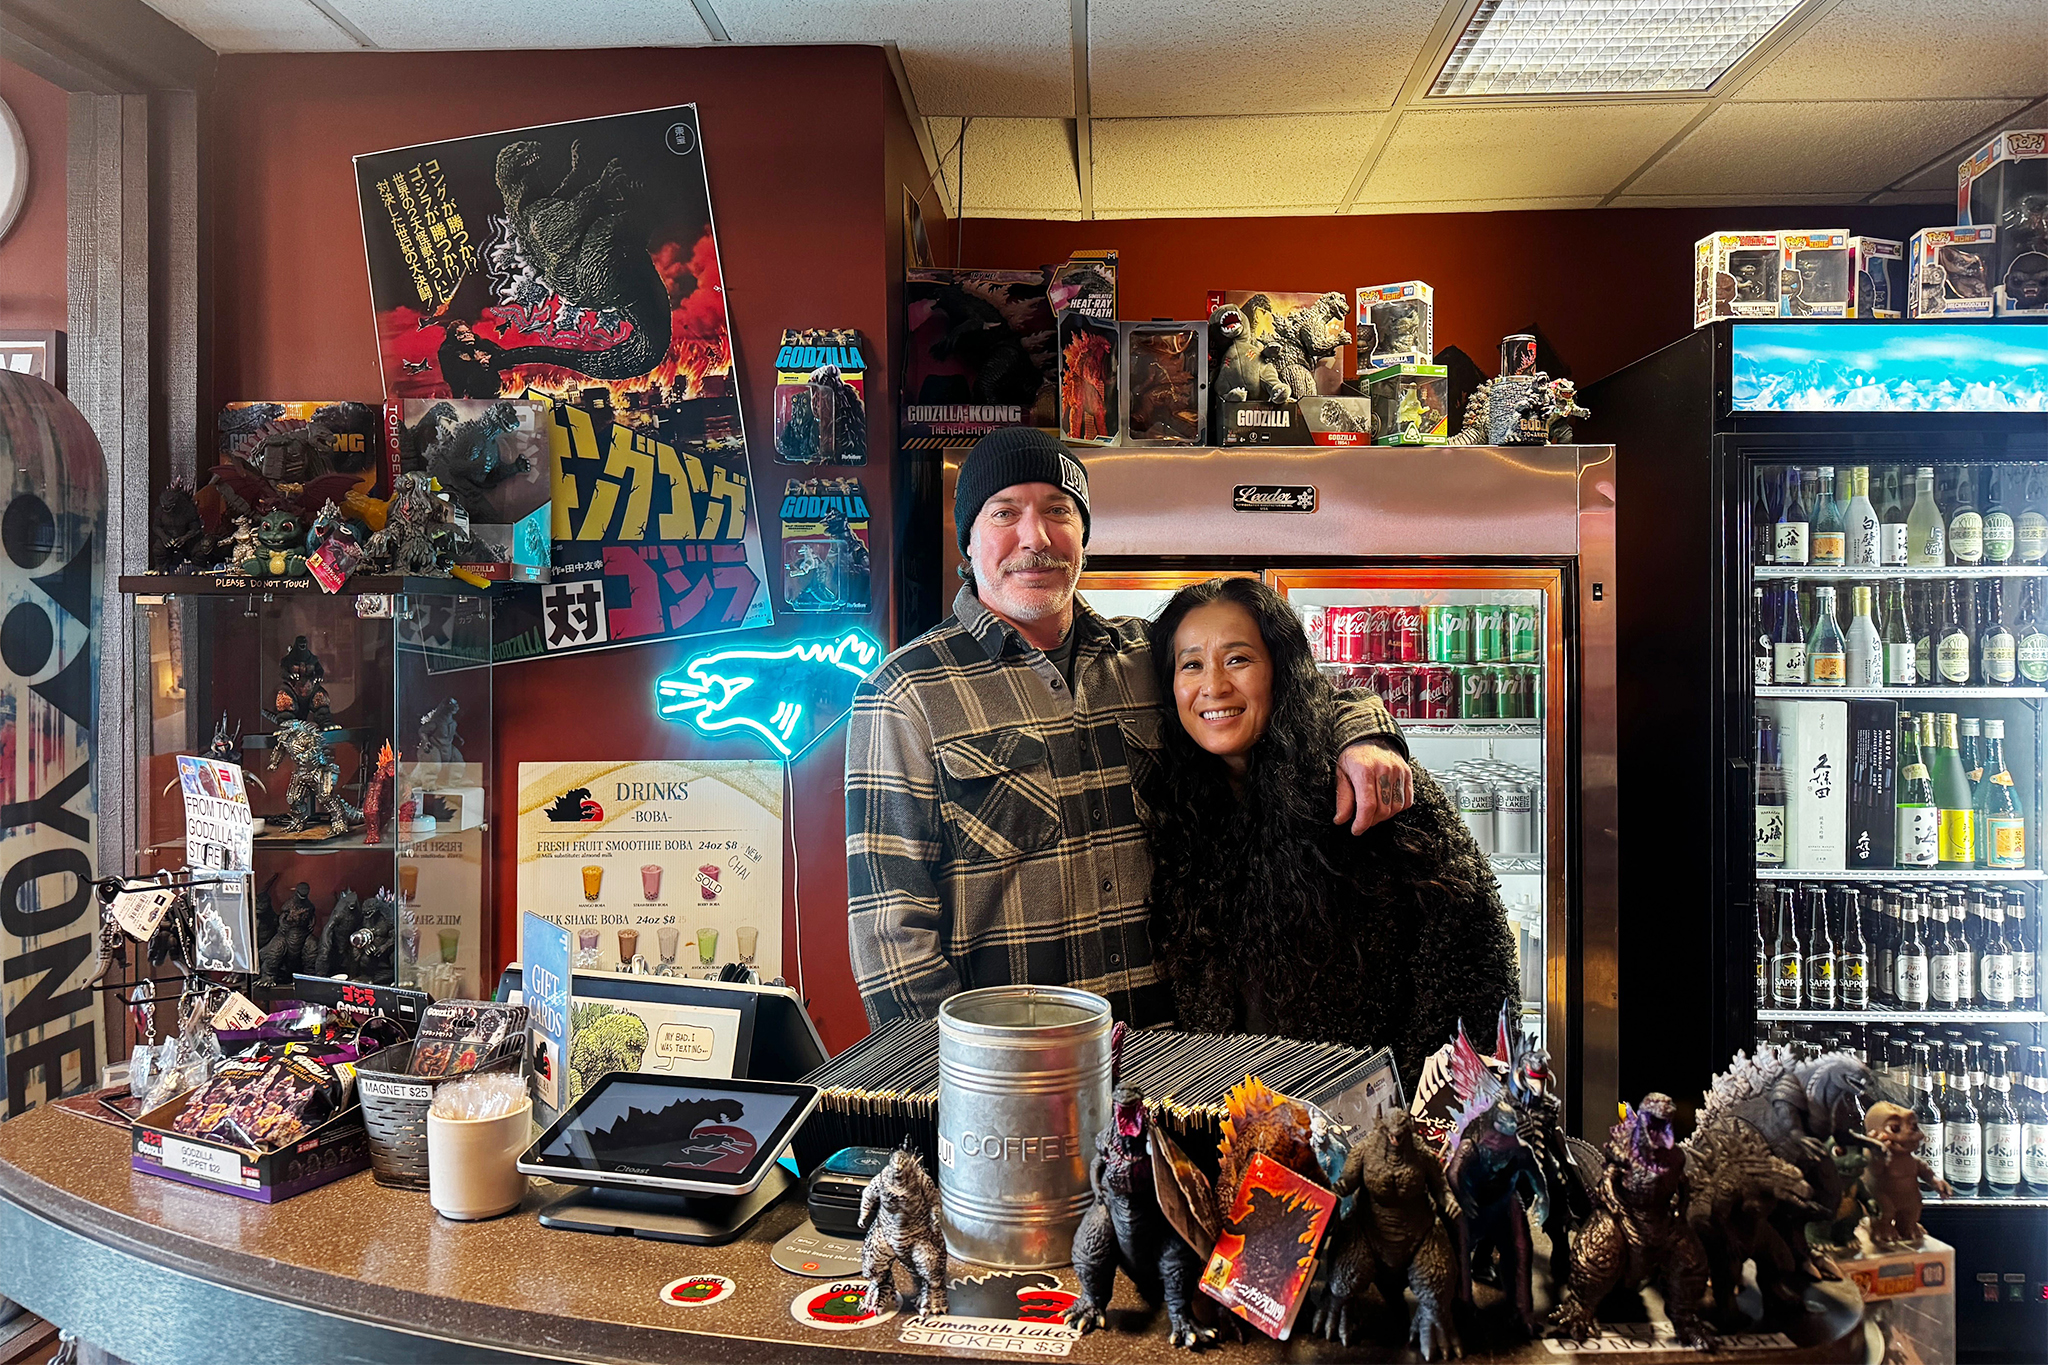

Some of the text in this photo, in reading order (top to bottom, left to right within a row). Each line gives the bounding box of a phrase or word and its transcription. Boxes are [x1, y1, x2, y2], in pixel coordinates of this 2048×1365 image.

[775, 345, 866, 369] GODZILLA
[907, 404, 1022, 422] GODZILLA KONG
[1237, 409, 1291, 428] GODZILLA
[388, 404, 400, 450] TOHO
[1328, 434, 1357, 442] GODZILLA
[1235, 486, 1297, 504] Leader
[215, 578, 310, 588] PLEASE DO NOT TOUCH
[602, 544, 761, 642] ゴジラ
[545, 583, 602, 647] 対
[492, 624, 546, 661] GODZILLA
[615, 781, 689, 802] DRINKS
[186, 796, 251, 826] FROM TOKYO
[630, 809, 673, 823] -BOBA-
[188, 817, 234, 847] GODZILLA
[537, 839, 738, 852] FRESH FRUIT SMOOTHIE BOBA 24oz $8
[727, 854, 751, 881] CHAI
[695, 872, 724, 895] SOLD
[564, 914, 598, 925] SHAKE
[601, 914, 630, 925] BOBA
[636, 915, 661, 925] 24oz
[663, 914, 676, 926] $8
[532, 963, 560, 996] GIFT
[342, 985, 377, 1006] ゴジラ
[529, 996, 563, 1038] CARDS
[664, 1032, 674, 1042] MY
[675, 1032, 690, 1042] BAD.
[660, 1042, 673, 1052] WAS
[364, 1081, 429, 1098] MAGNET $25
[181, 1146, 214, 1162] GODZILLA
[961, 1131, 1081, 1163] COFFEE
[1944, 1141, 1980, 1158] Asahi
[182, 1158, 221, 1174] PUPPET $22
[624, 1165, 650, 1175] toast
[795, 1246, 811, 1255] just
[812, 1249, 833, 1259] insert
[834, 1253, 847, 1261] the
[906, 1316, 1080, 1341] Mammoth Lakes
[903, 1330, 1067, 1355] STICKER $3
[1558, 1338, 1602, 1352] DO
